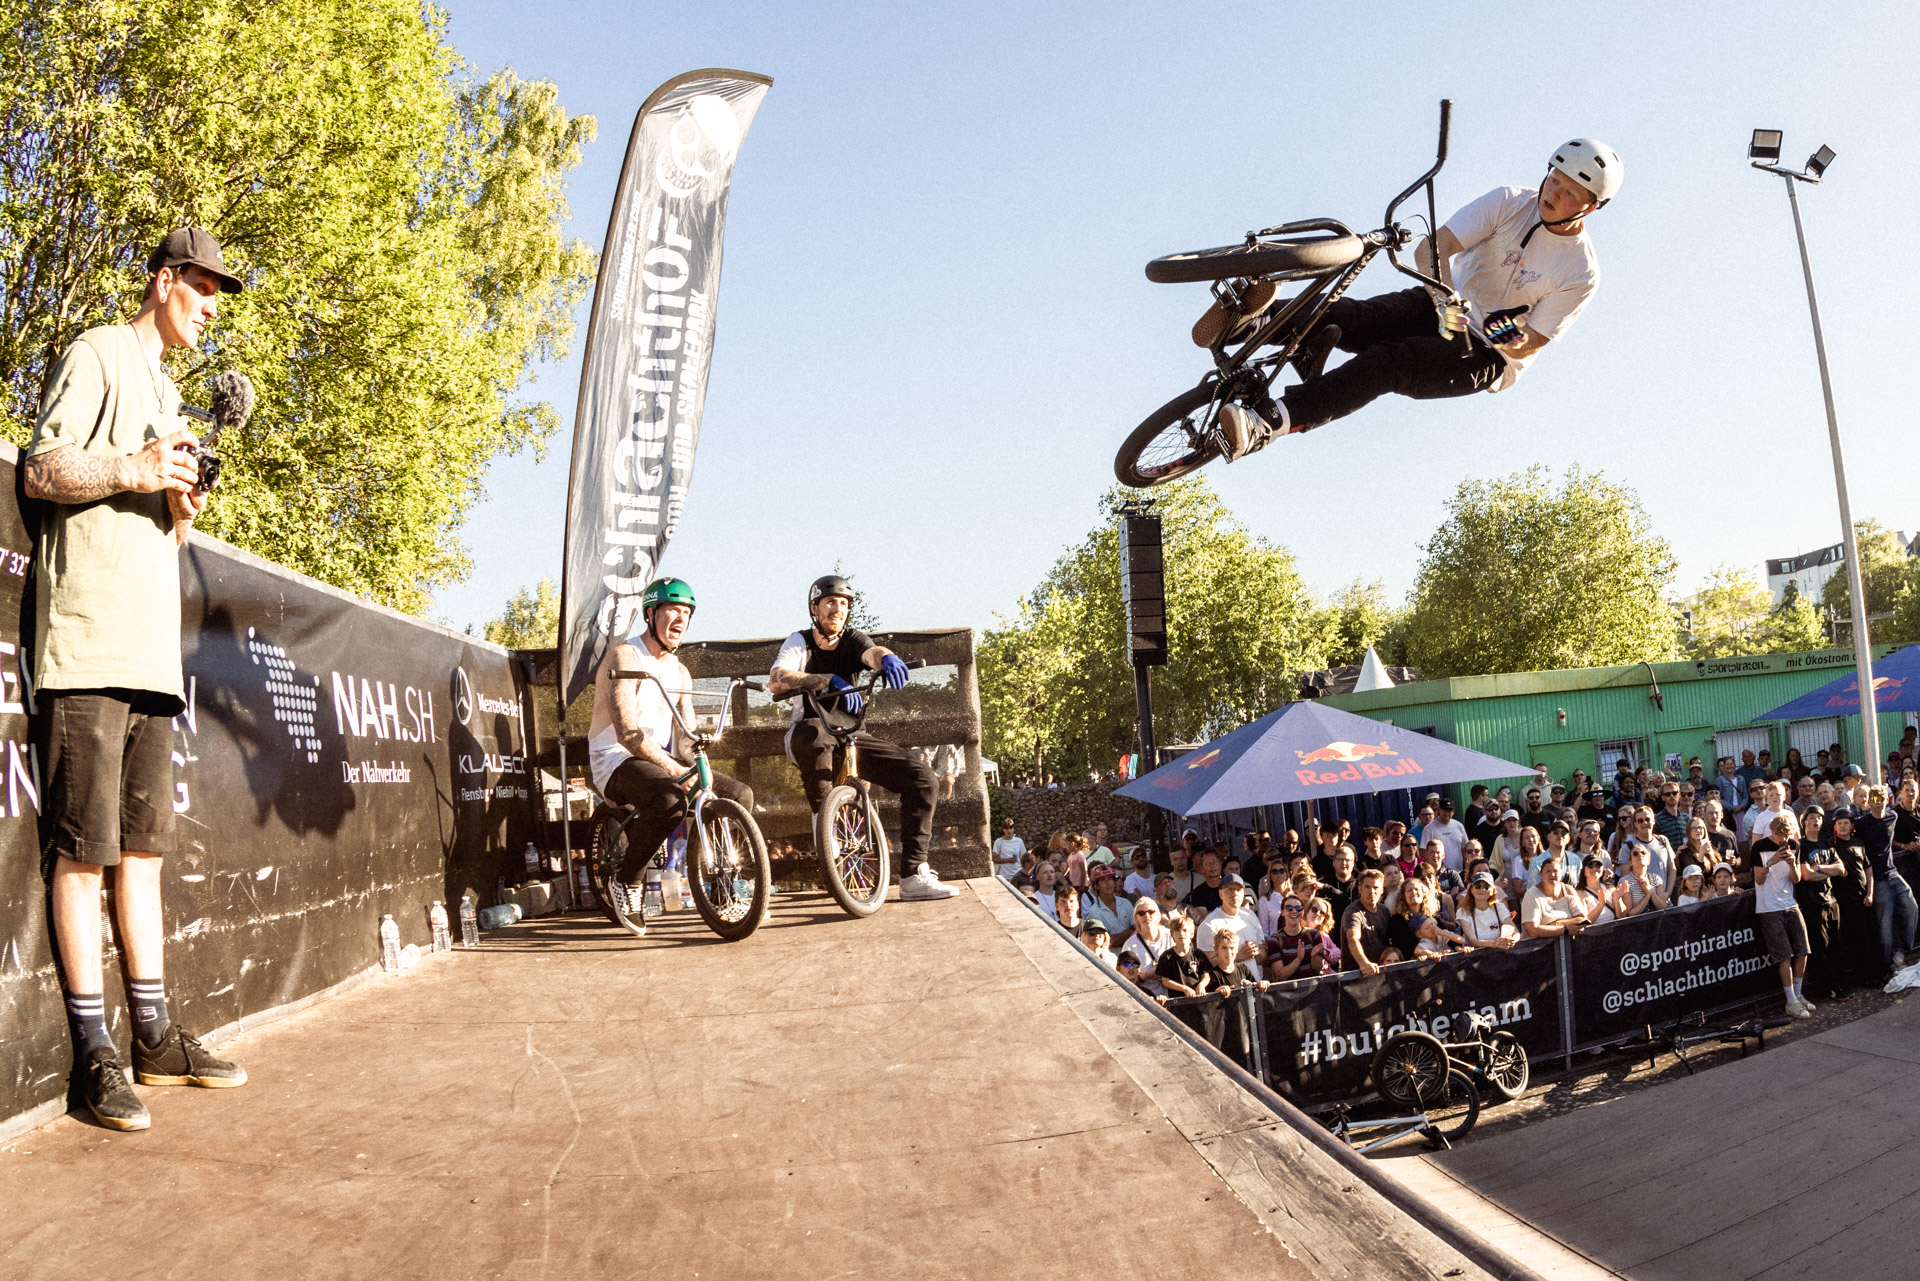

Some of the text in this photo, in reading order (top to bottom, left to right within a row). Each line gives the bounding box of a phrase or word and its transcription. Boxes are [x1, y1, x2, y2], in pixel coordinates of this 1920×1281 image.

[1786, 659, 1802, 668] mit
[1805, 653, 1849, 666] Ökostrom
[332, 671, 436, 743] NAH.SH
[342, 760, 412, 784] Der Nahverkehr
[1295, 758, 1424, 786] Red Bull
[1620, 927, 1755, 976] @sportpiraten
[1603, 953, 1772, 1014] @schlachthofbmx
[1301, 998, 1532, 1066] #butcheam
